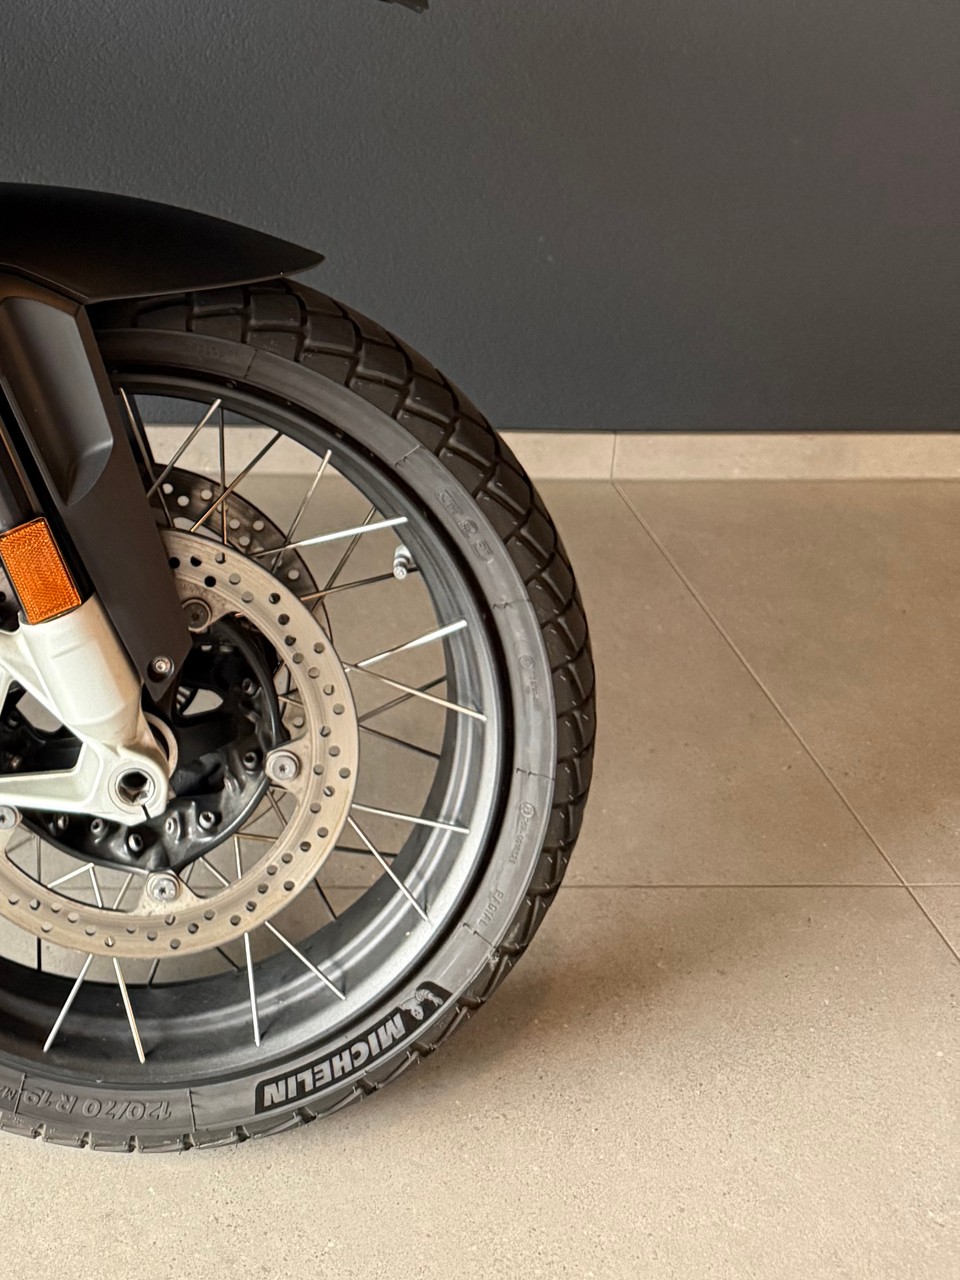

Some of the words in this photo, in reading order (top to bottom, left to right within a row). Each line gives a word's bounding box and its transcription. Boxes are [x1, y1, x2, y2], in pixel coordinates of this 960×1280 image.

[263, 1012, 407, 1108] MICHELIN
[22, 1088, 53, 1108] 19
[55, 1093, 79, 1114] R
[81, 1098, 173, 1121] 120/70
